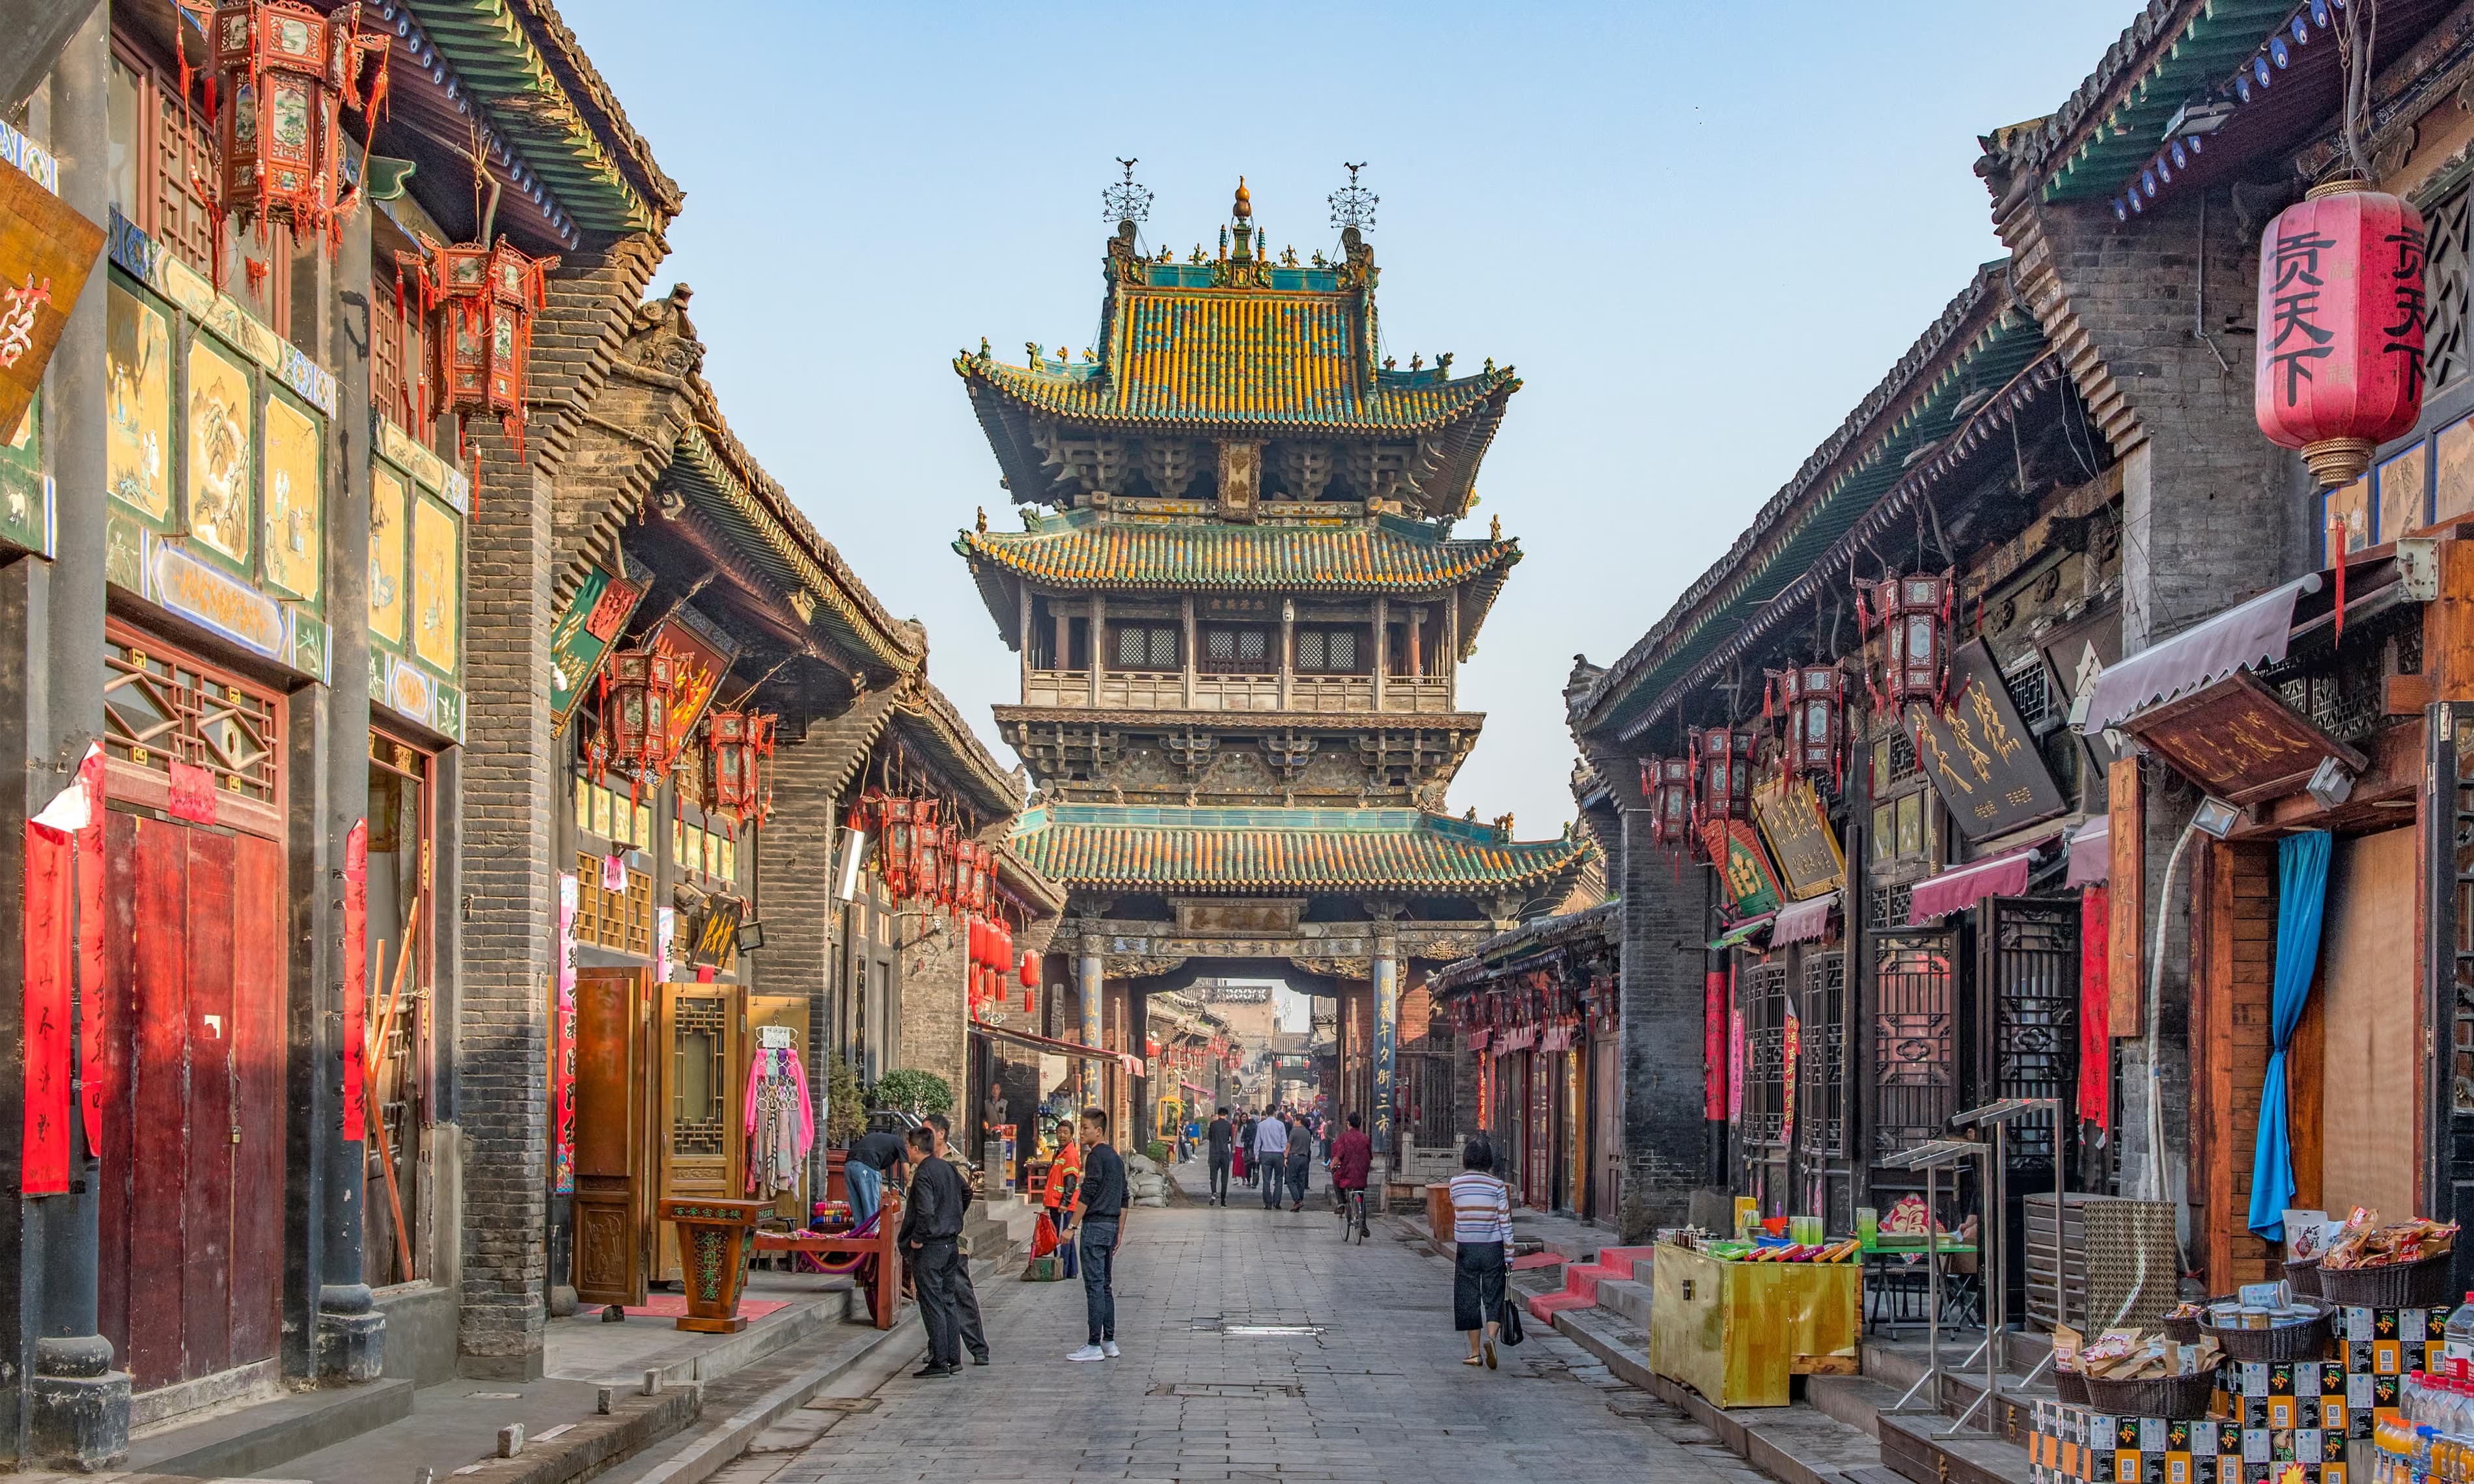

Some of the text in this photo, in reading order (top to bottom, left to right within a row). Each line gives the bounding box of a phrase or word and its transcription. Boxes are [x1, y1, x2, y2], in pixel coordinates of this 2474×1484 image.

[2267, 230, 2337, 407] 贡天下
[2383, 225, 2426, 404] 贡天下
[1375, 977, 1392, 1136] 朝晨午夕街三市
